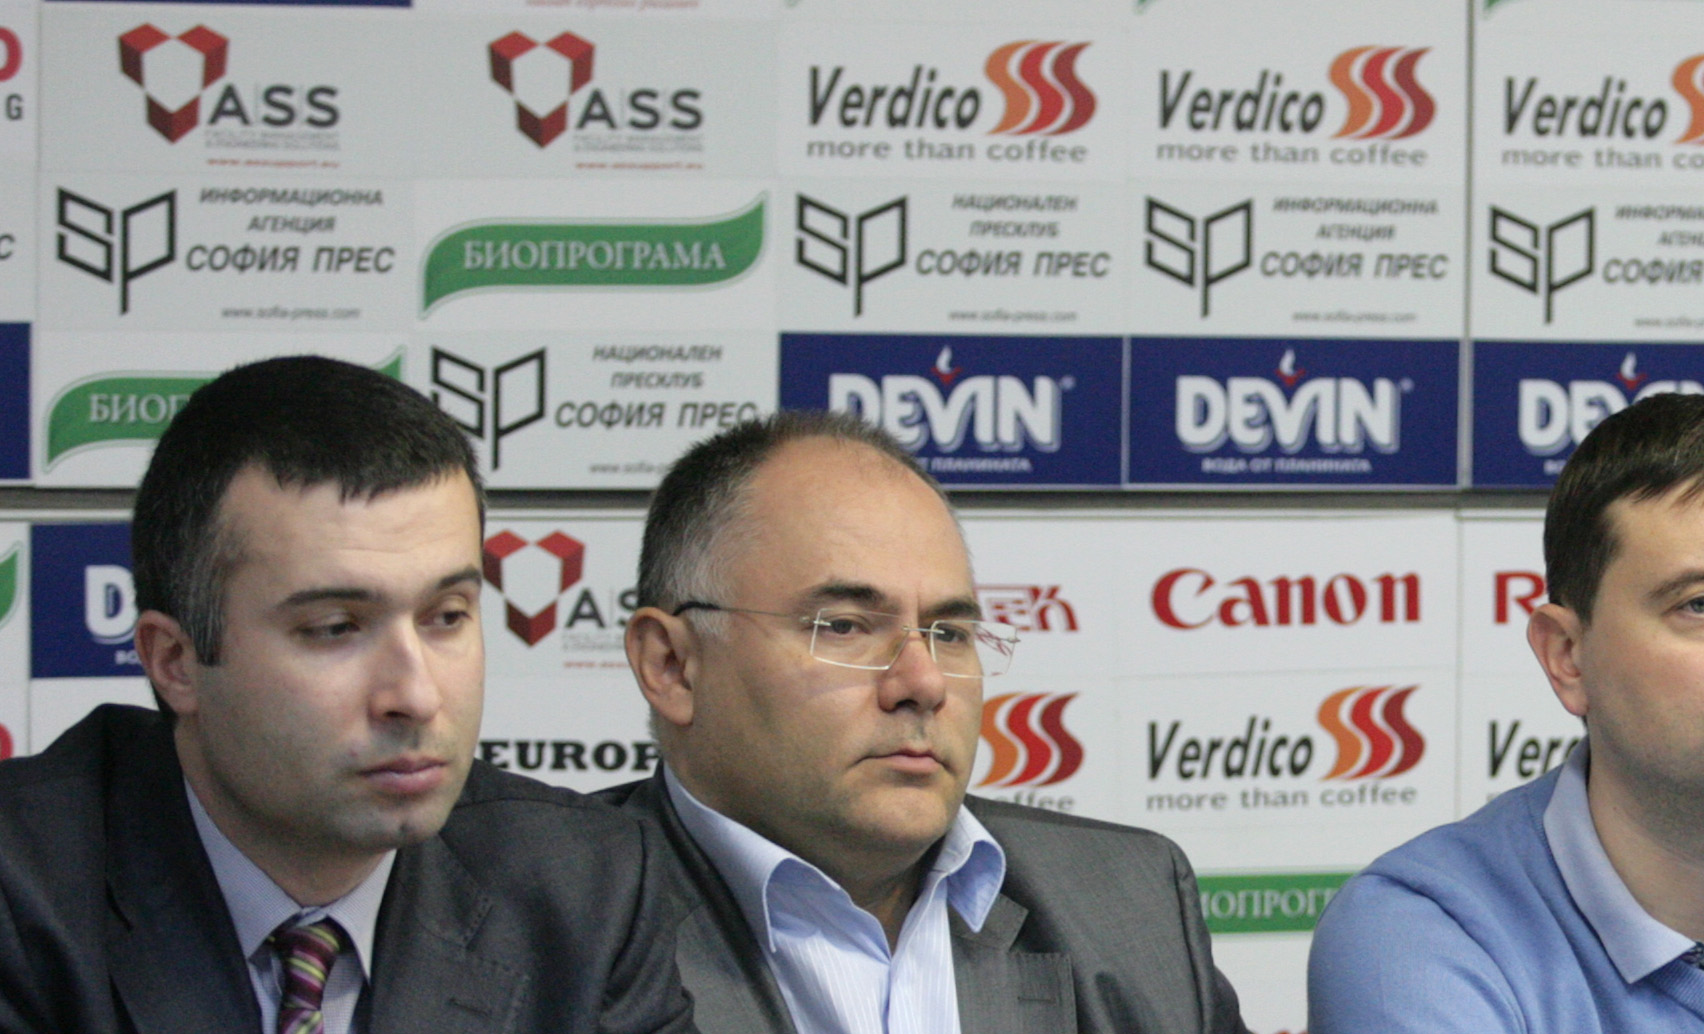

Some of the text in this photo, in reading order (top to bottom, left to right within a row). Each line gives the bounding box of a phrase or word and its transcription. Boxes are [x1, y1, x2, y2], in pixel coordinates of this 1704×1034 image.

[808, 65, 982, 130] Verdico
[1158, 69, 1325, 132] Verdico
[1504, 76, 1669, 138] Verdico
[806, 138, 1088, 162] more than coffee
[1156, 141, 1427, 166] more than coffee
[1502, 149, 1582, 167] more
[1594, 147, 1662, 168] than
[199, 188, 384, 206] ИНФОРМАЦИОННА
[248, 216, 336, 235] АГЕНЦИЯ
[185, 244, 395, 273] СОФИЯ ПРЕС
[463, 240, 727, 270] БИОПРОГРАМА
[915, 248, 1110, 278] СОФИЯ ПРЕС
[1260, 250, 1449, 280] СОФИЯ ПРЕС
[1602, 257, 1704, 286] СОФИЯ
[592, 346, 722, 362] НАЦИОНАЛЕН
[610, 372, 704, 389] ПРЕСКЛУБ
[555, 401, 664, 430] СОФИЯ
[1175, 376, 1400, 452] DEVIN
[1150, 568, 1421, 630] Canon
[1147, 716, 1314, 780] Verdico
[1146, 781, 1418, 812] more than coffee
